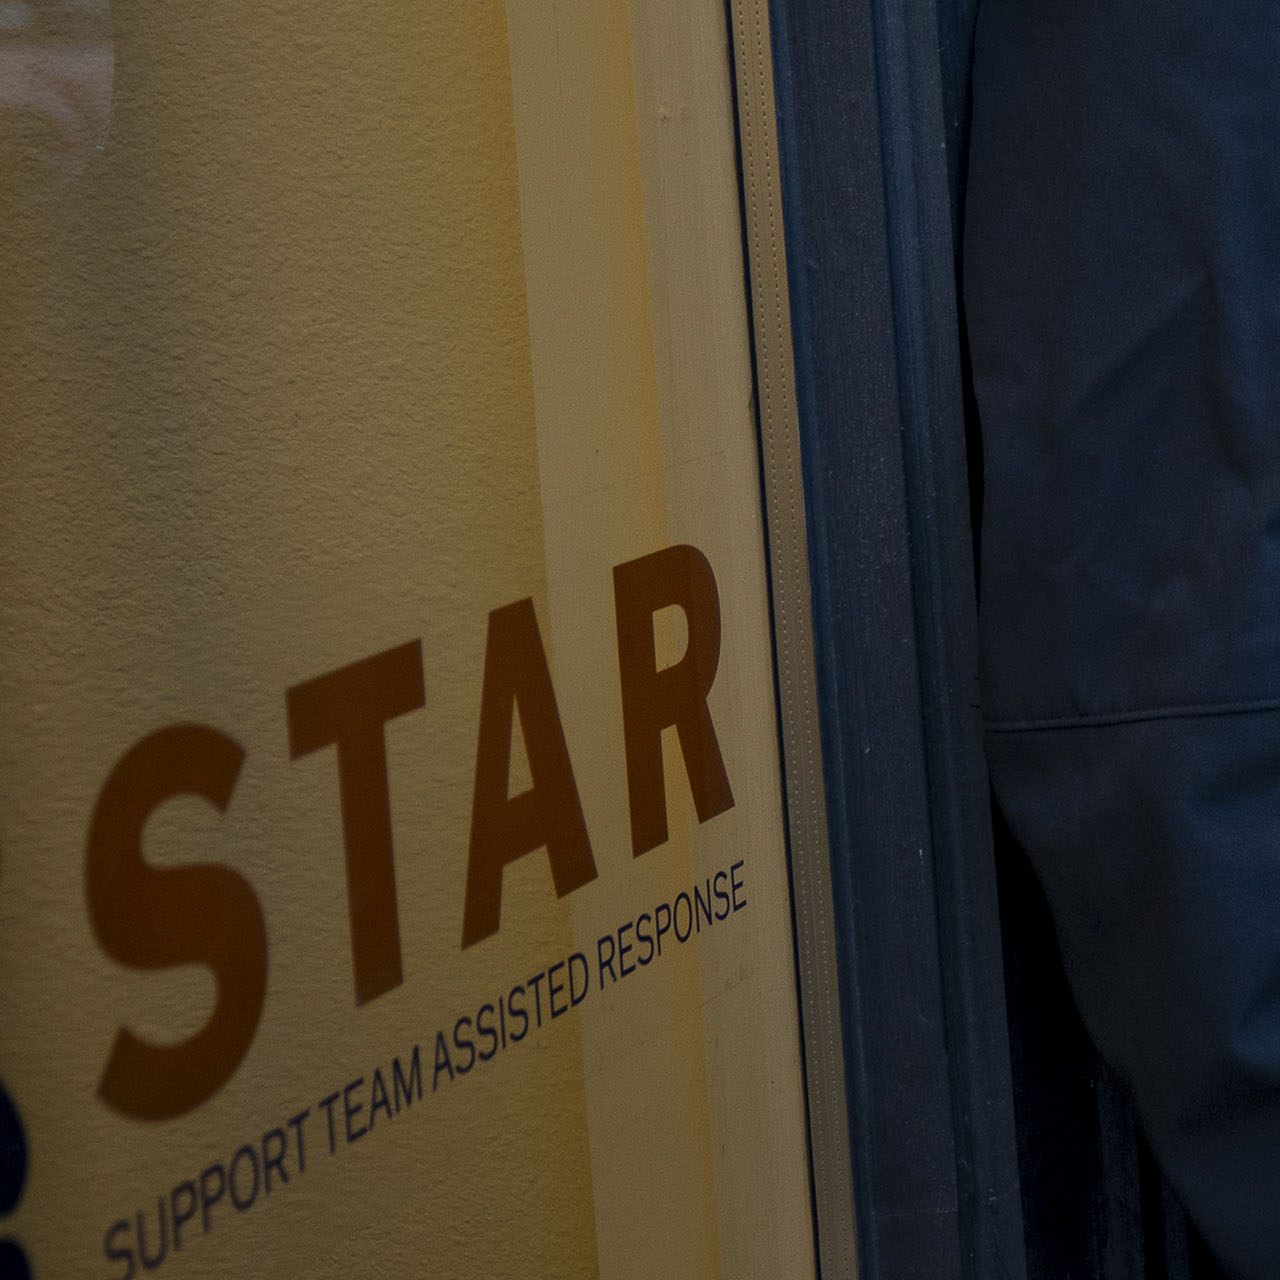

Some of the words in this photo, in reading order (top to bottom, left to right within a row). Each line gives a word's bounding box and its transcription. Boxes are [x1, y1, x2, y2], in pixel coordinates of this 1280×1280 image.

[84, 543, 736, 1124] STAR
[103, 1108, 311, 1280] SUPPORT
[318, 1044, 423, 1155] TEAM
[432, 952, 590, 1092] ASSISTED
[597, 859, 748, 991] RESPONSE
